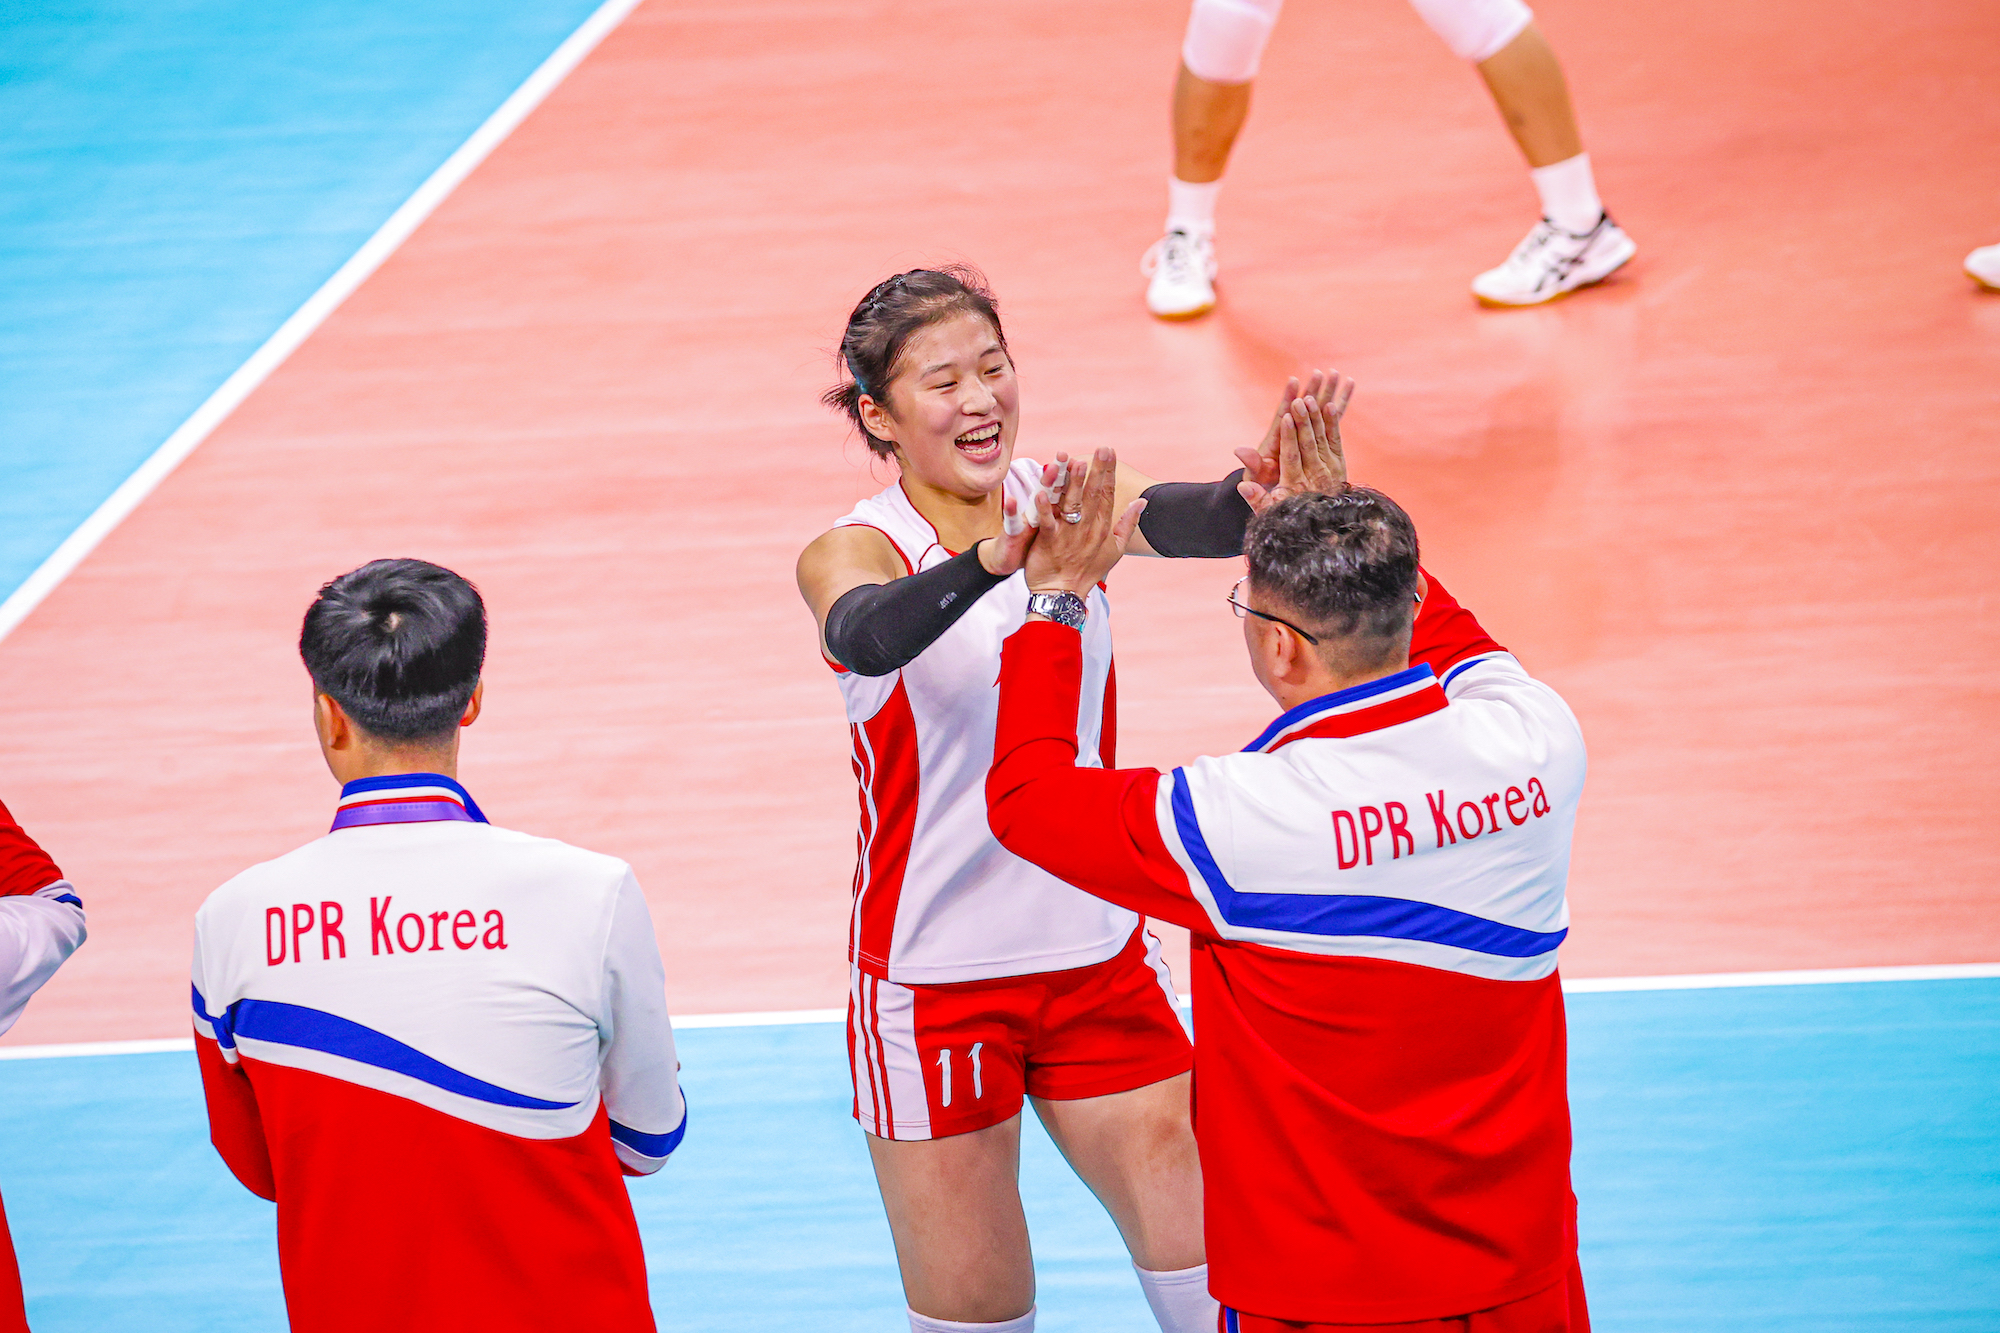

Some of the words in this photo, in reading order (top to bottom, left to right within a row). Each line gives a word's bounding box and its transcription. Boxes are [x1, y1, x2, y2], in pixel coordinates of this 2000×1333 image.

[1331, 801, 1415, 870] DPR
[1425, 777, 1551, 848] Korea
[265, 901, 346, 967] DPR
[370, 896, 508, 956] Korea
[936, 1042, 983, 1107] 11
